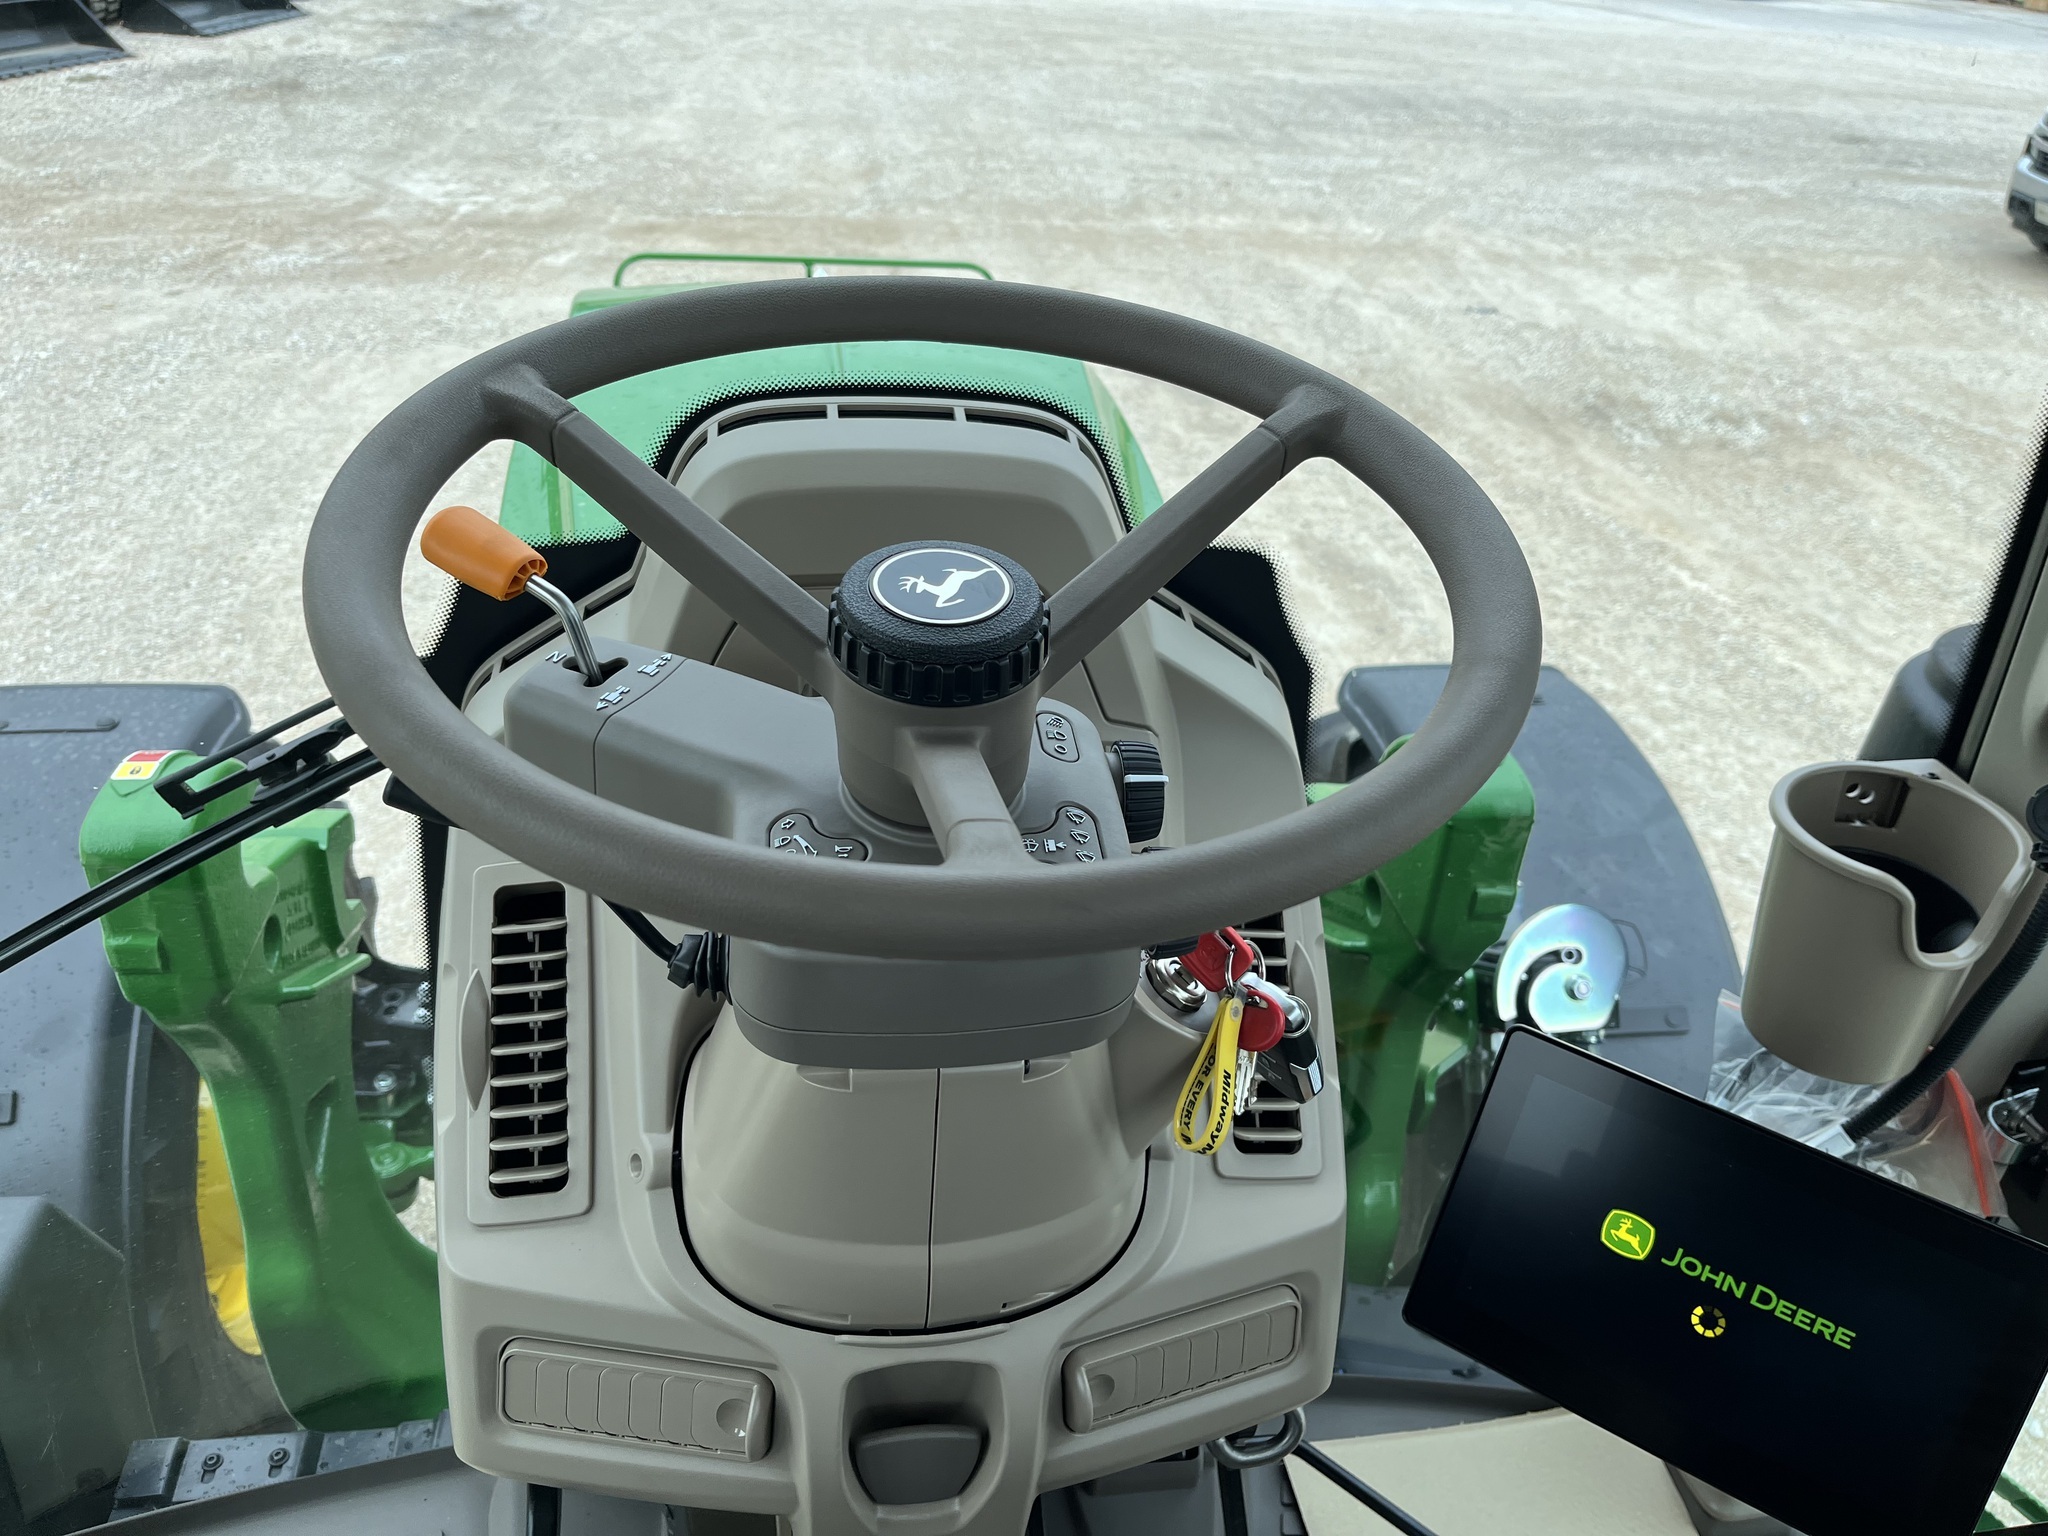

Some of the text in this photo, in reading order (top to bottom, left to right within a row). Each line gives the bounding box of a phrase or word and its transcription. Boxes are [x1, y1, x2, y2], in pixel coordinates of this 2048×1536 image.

[1183, 1080, 1205, 1131] EVERY
[1661, 1248, 1856, 1350] JOHN DEERE
